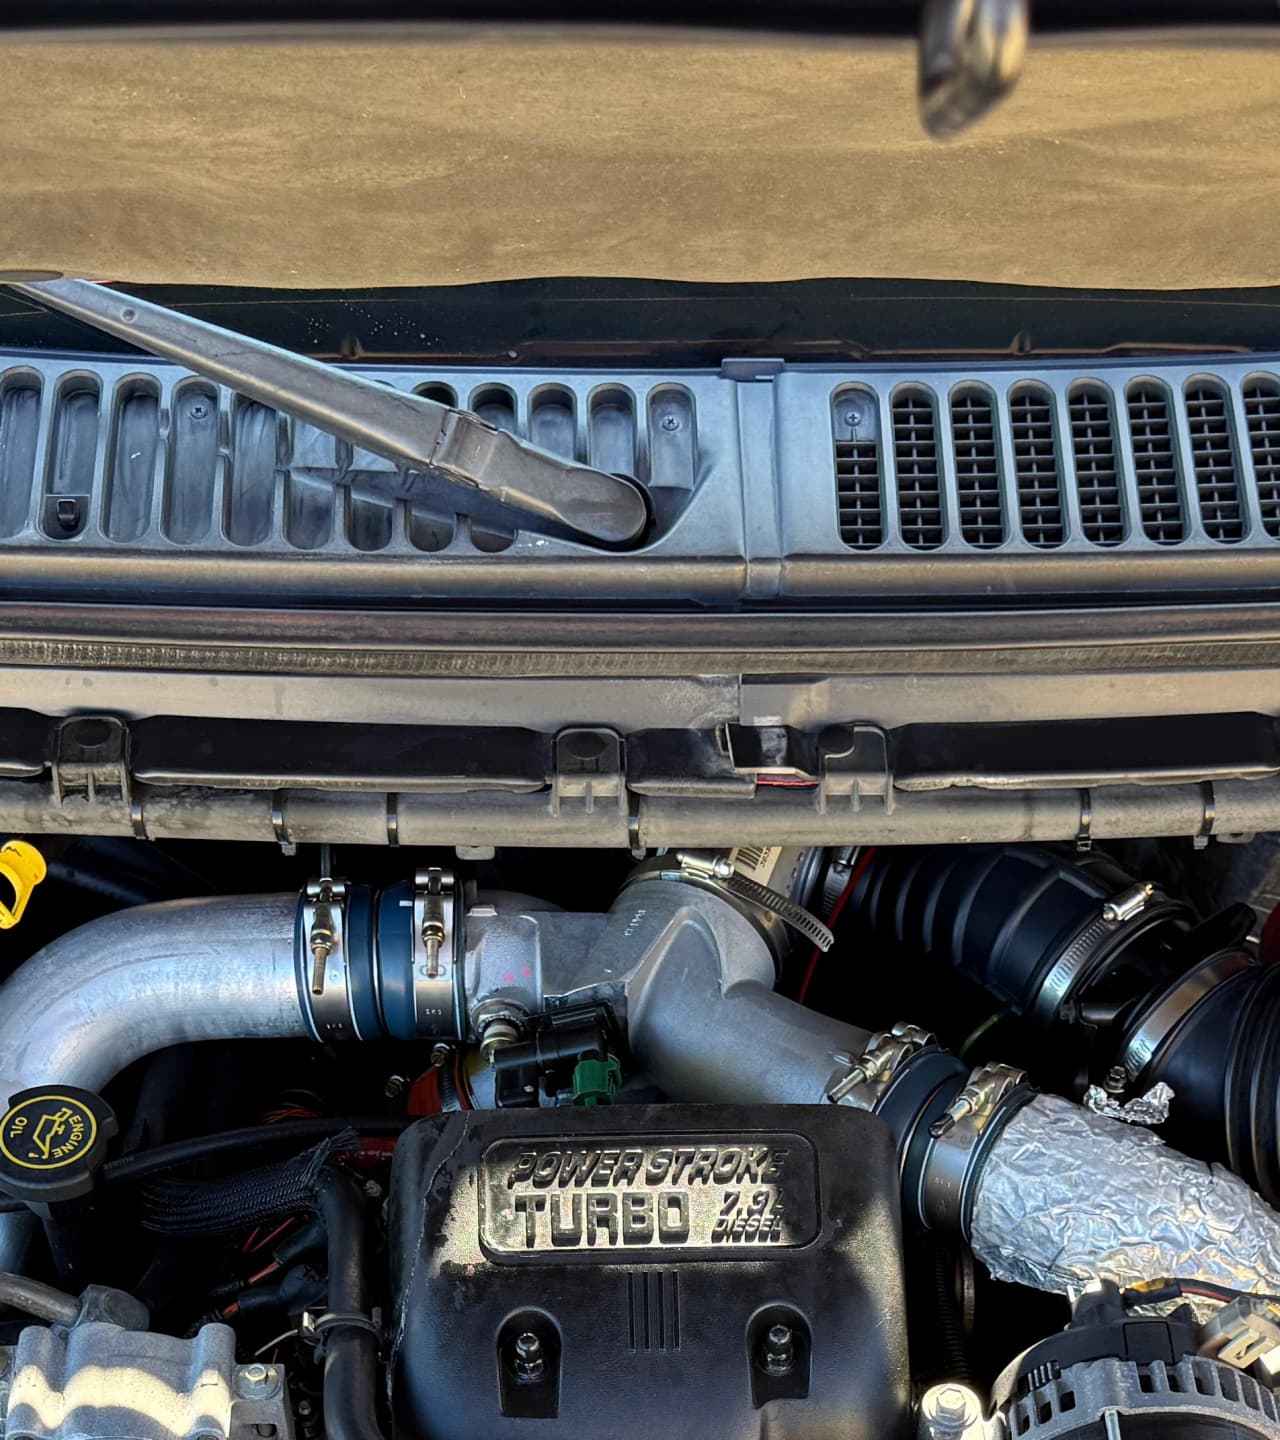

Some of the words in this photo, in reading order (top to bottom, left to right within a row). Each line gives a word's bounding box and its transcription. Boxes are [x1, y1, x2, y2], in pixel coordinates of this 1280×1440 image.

[9, 1116, 29, 1139] OIL
[52, 1115, 84, 1159] ENGINE
[508, 1148, 642, 1189] POWER
[645, 1146, 790, 1186] STROKE
[513, 1190, 691, 1248] TURBO
[722, 1188, 786, 1216] 7.3L
[711, 1215, 784, 1244] DIESEL
